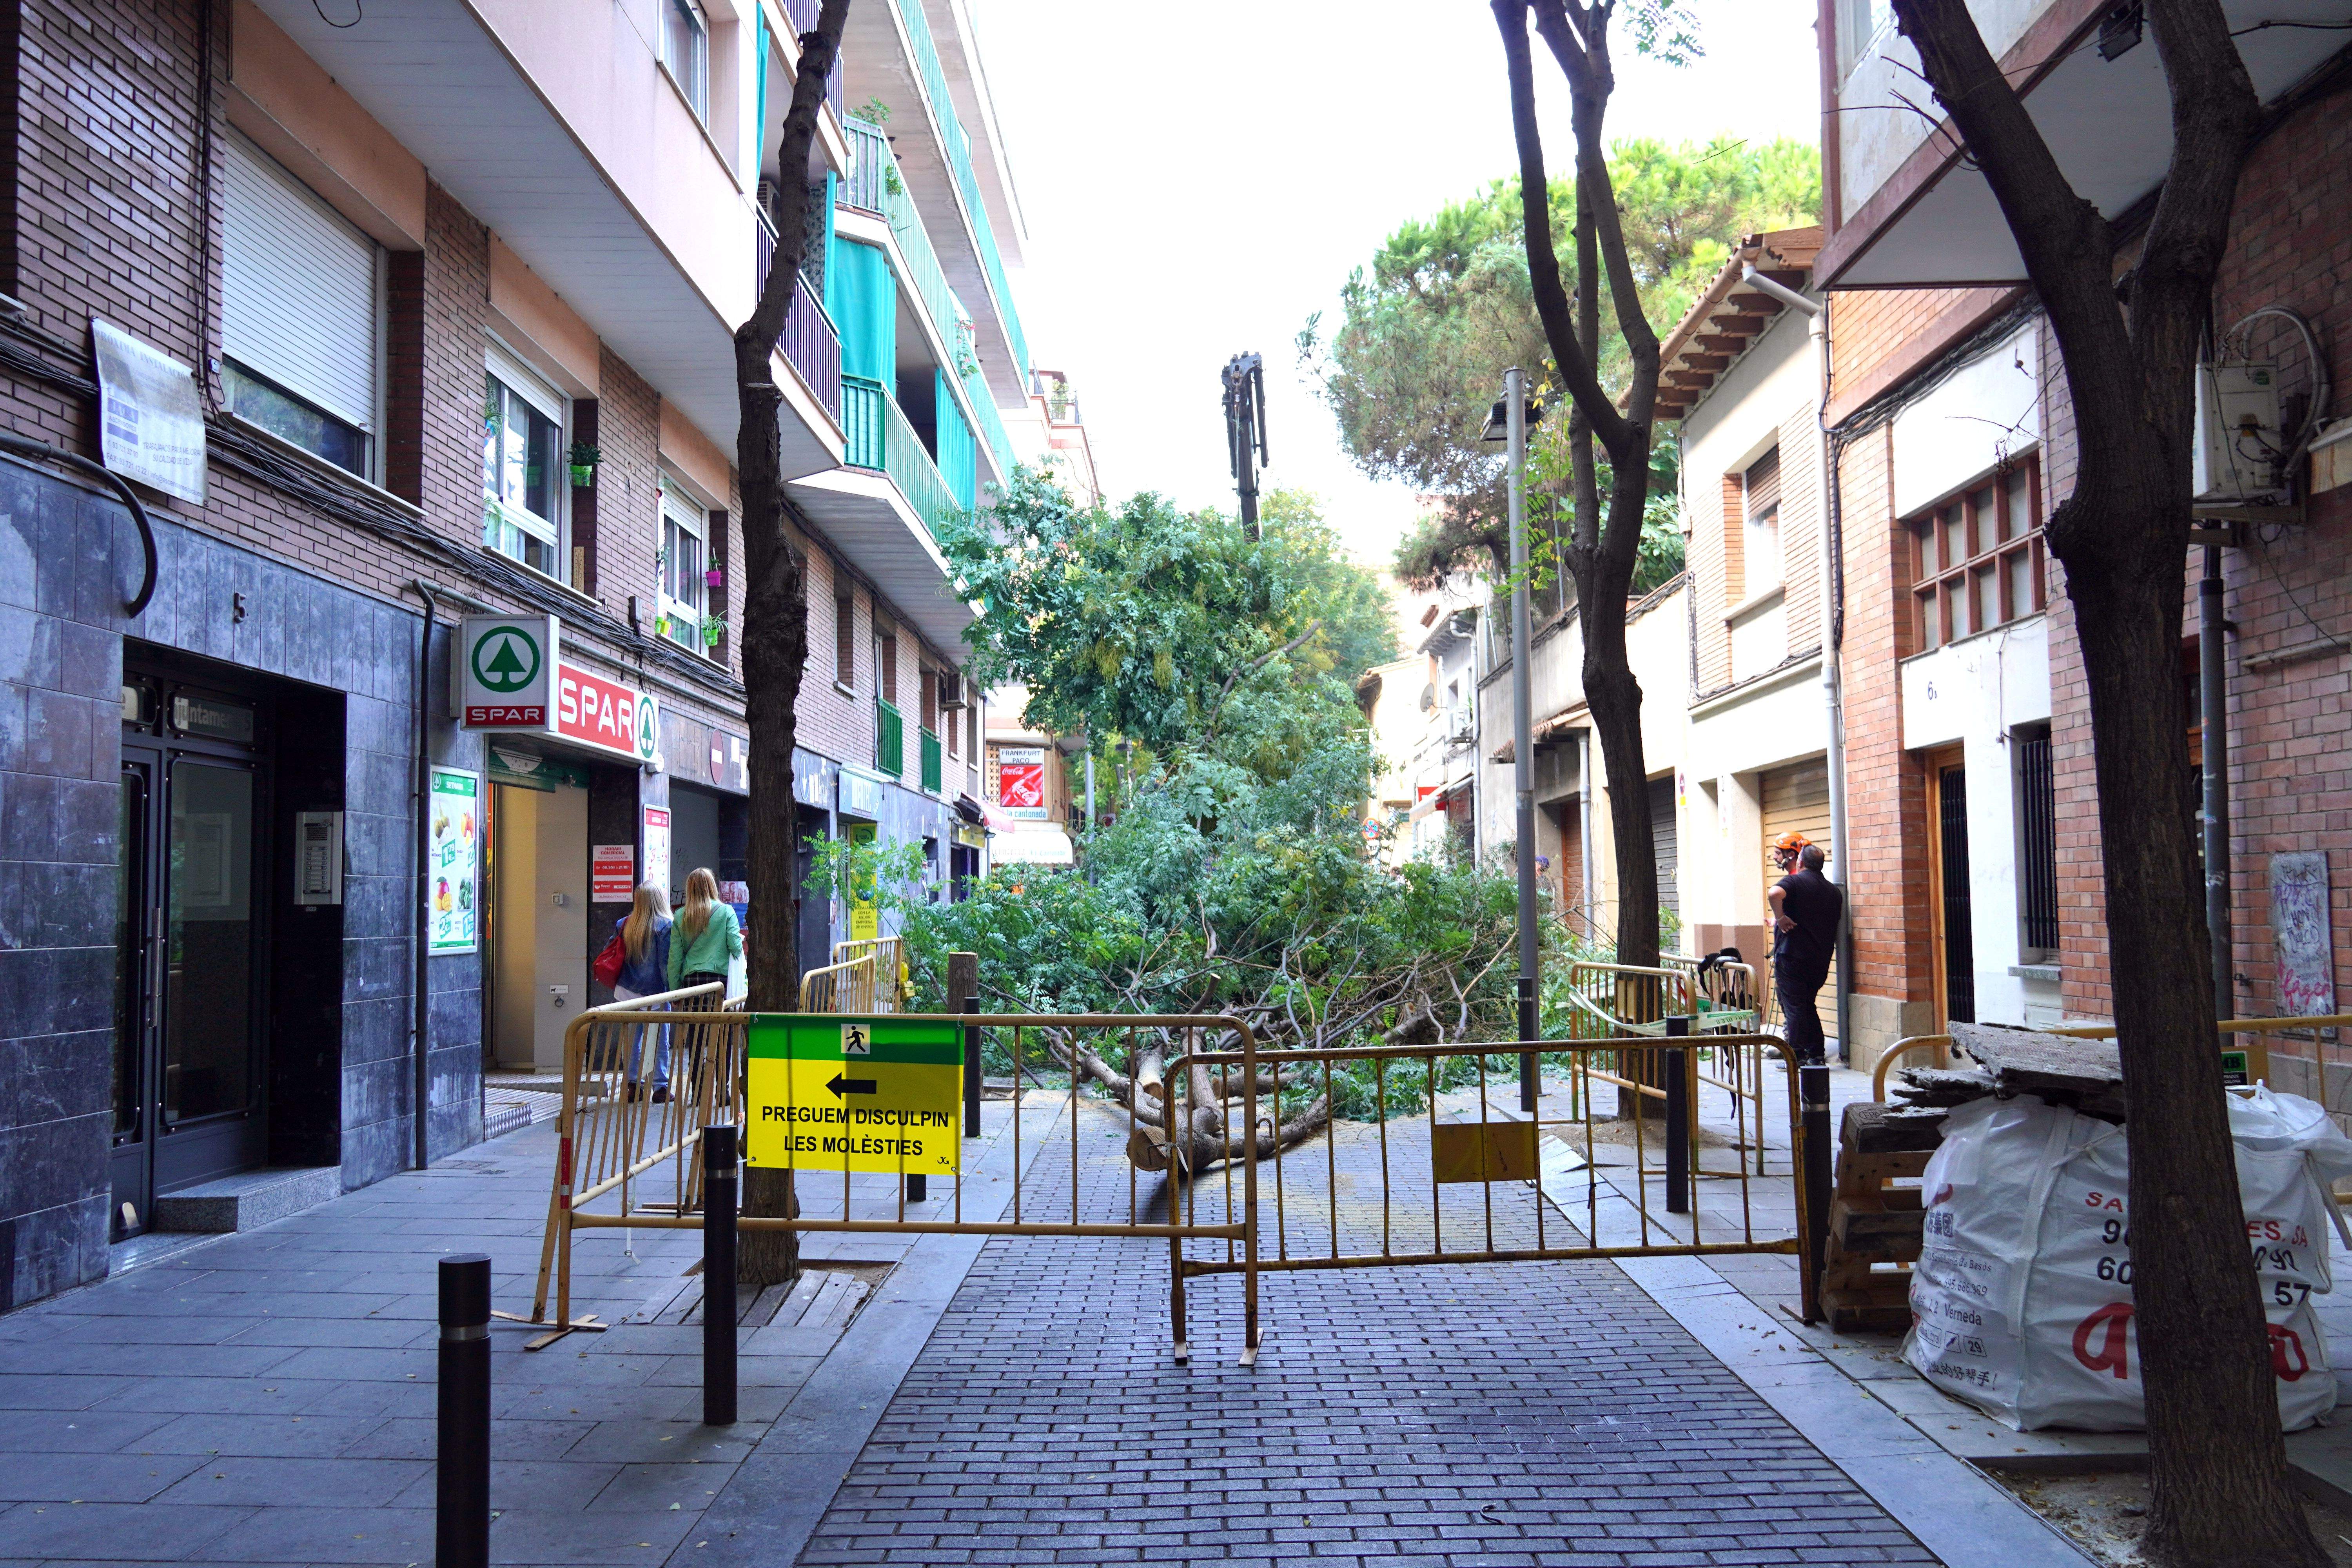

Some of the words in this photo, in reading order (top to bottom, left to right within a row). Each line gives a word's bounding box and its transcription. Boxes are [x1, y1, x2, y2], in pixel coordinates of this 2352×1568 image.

[472, 708, 540, 721] SPAR
[560, 678, 634, 741] SPAR
[1014, 809, 1046, 818] cantonada
[762, 1106, 849, 1124] PREGUEM
[855, 1109, 949, 1127] DISCULPIN
[784, 1136, 817, 1152] LES
[822, 1134, 923, 1156] MOLÈSTIES
[1959, 1257, 1968, 1267] de
[1969, 1259, 1992, 1272] Besòs
[2274, 1281, 2312, 1308] 57
[1944, 1303, 1982, 1326] Verneda
[1967, 1340, 1982, 1353] 29
